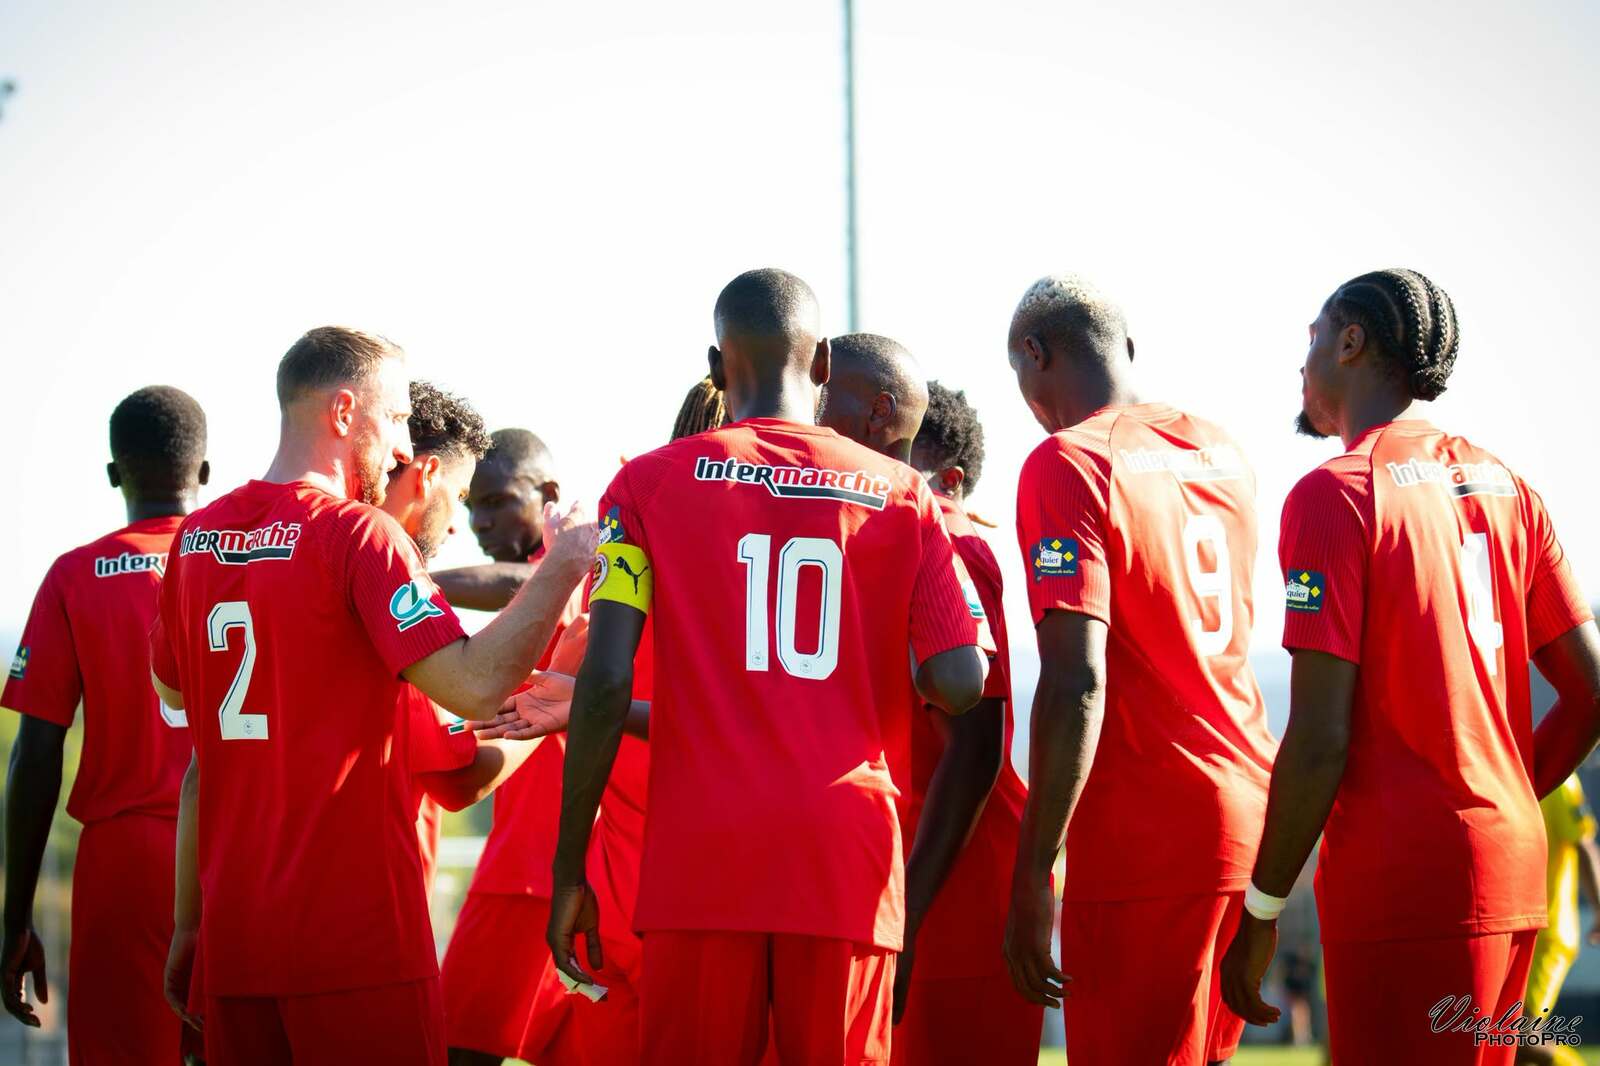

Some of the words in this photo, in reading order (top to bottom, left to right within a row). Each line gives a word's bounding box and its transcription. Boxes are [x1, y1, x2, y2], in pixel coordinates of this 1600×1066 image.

[95, 552, 168, 578] Inter
[180, 521, 302, 563] Intermarché
[737, 533, 842, 680] 10
[1185, 514, 1232, 656] 9
[1461, 533, 1503, 675] 4
[207, 601, 269, 740] 2
